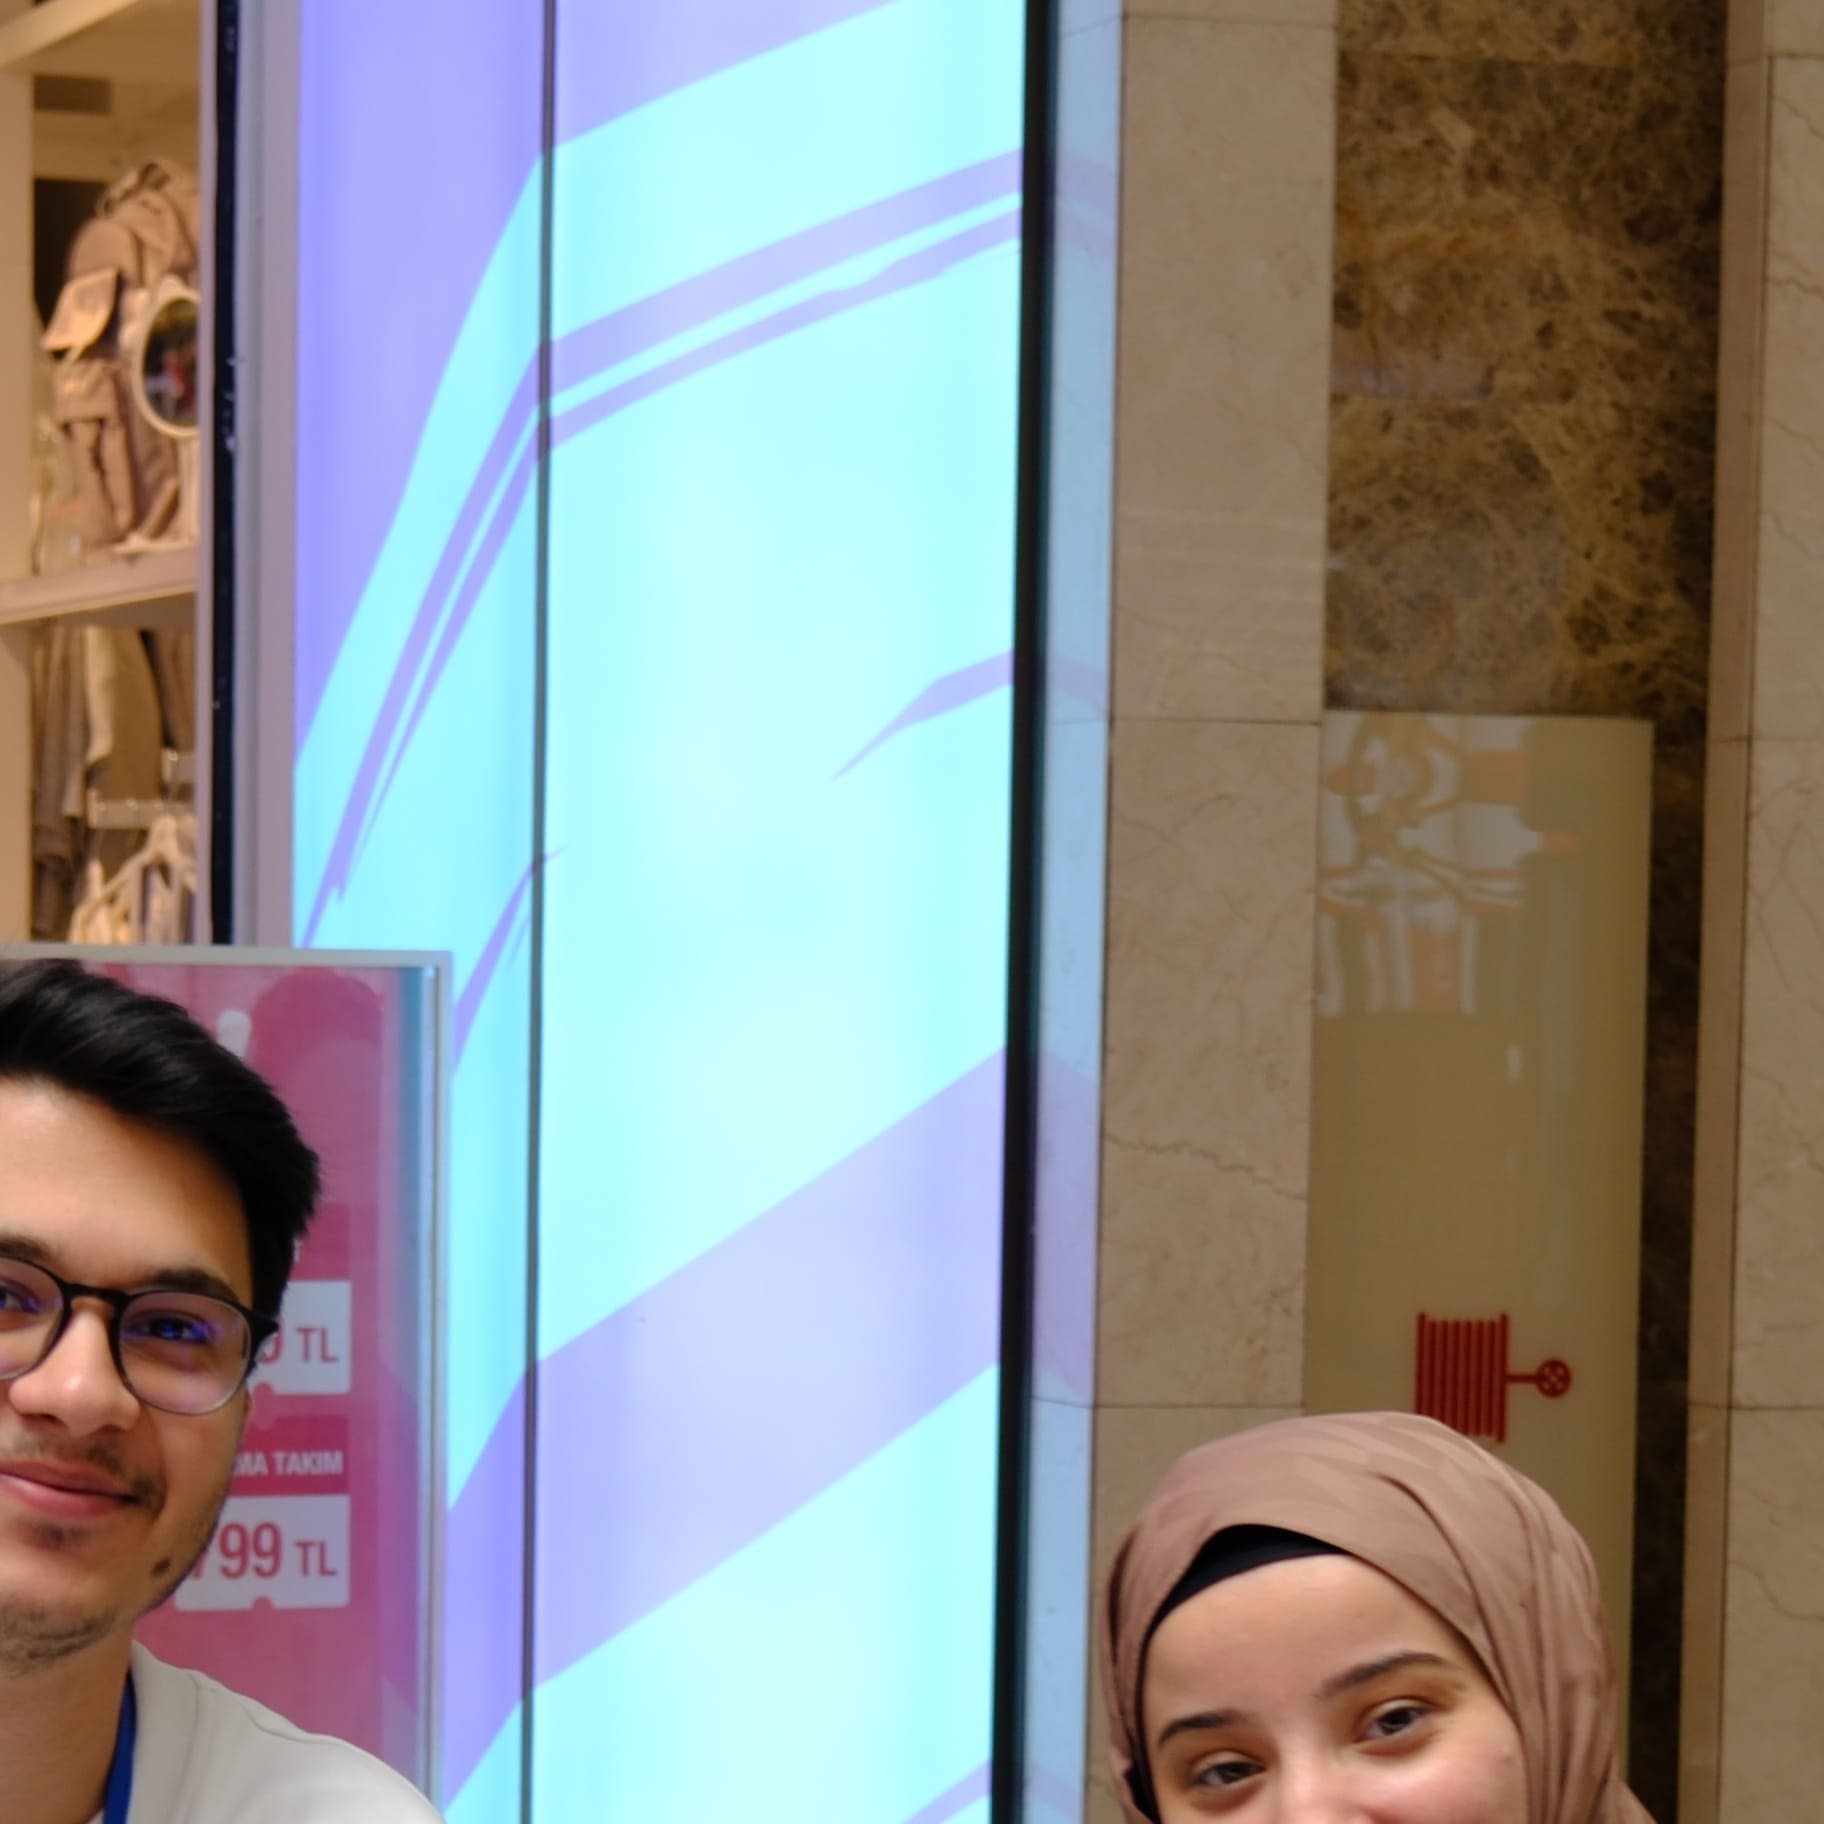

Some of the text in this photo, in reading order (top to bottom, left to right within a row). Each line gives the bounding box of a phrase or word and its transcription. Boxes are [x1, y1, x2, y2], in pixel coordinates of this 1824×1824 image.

[296, 1326, 340, 1363] TL
[271, 1450, 344, 1476] TAKIM
[192, 1521, 339, 1580] 99 TL
